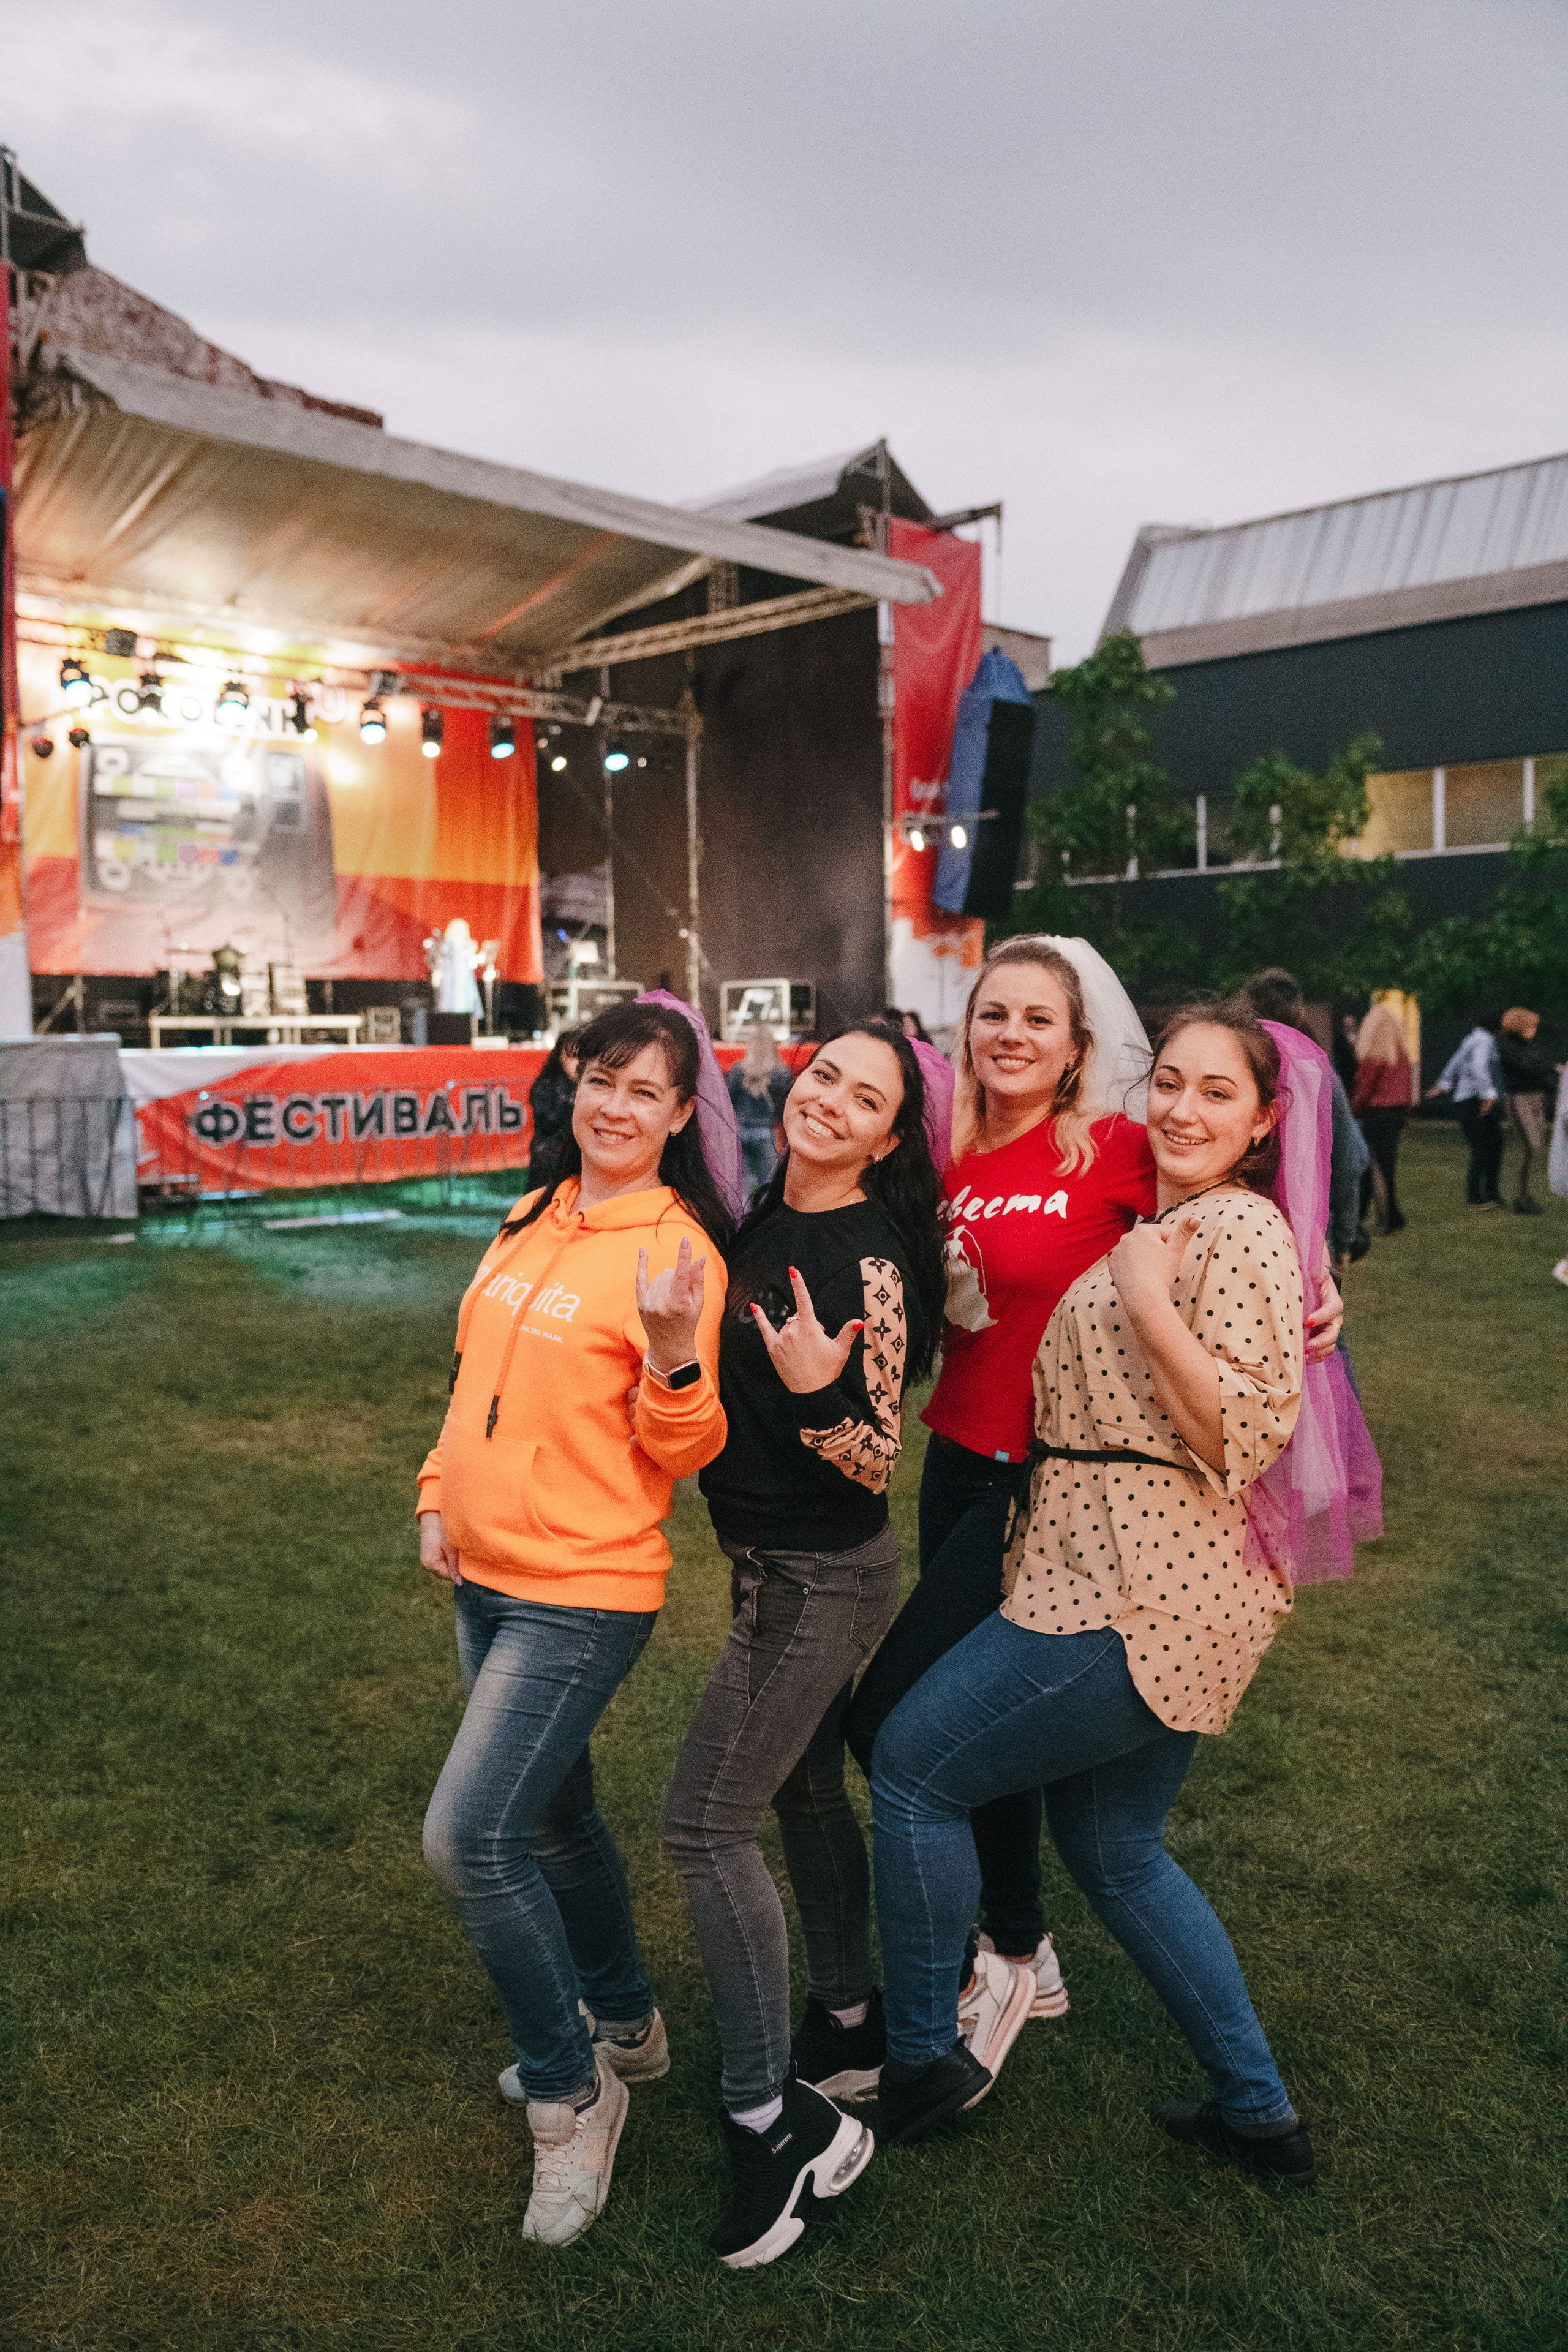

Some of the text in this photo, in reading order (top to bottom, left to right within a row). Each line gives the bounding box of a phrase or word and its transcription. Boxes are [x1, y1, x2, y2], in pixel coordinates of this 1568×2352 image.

[193, 1091, 523, 1144] ФЕСТИВАЛЬ
[935, 1185, 1069, 1221] евеста
[542, 1331, 564, 1343] MARK.
